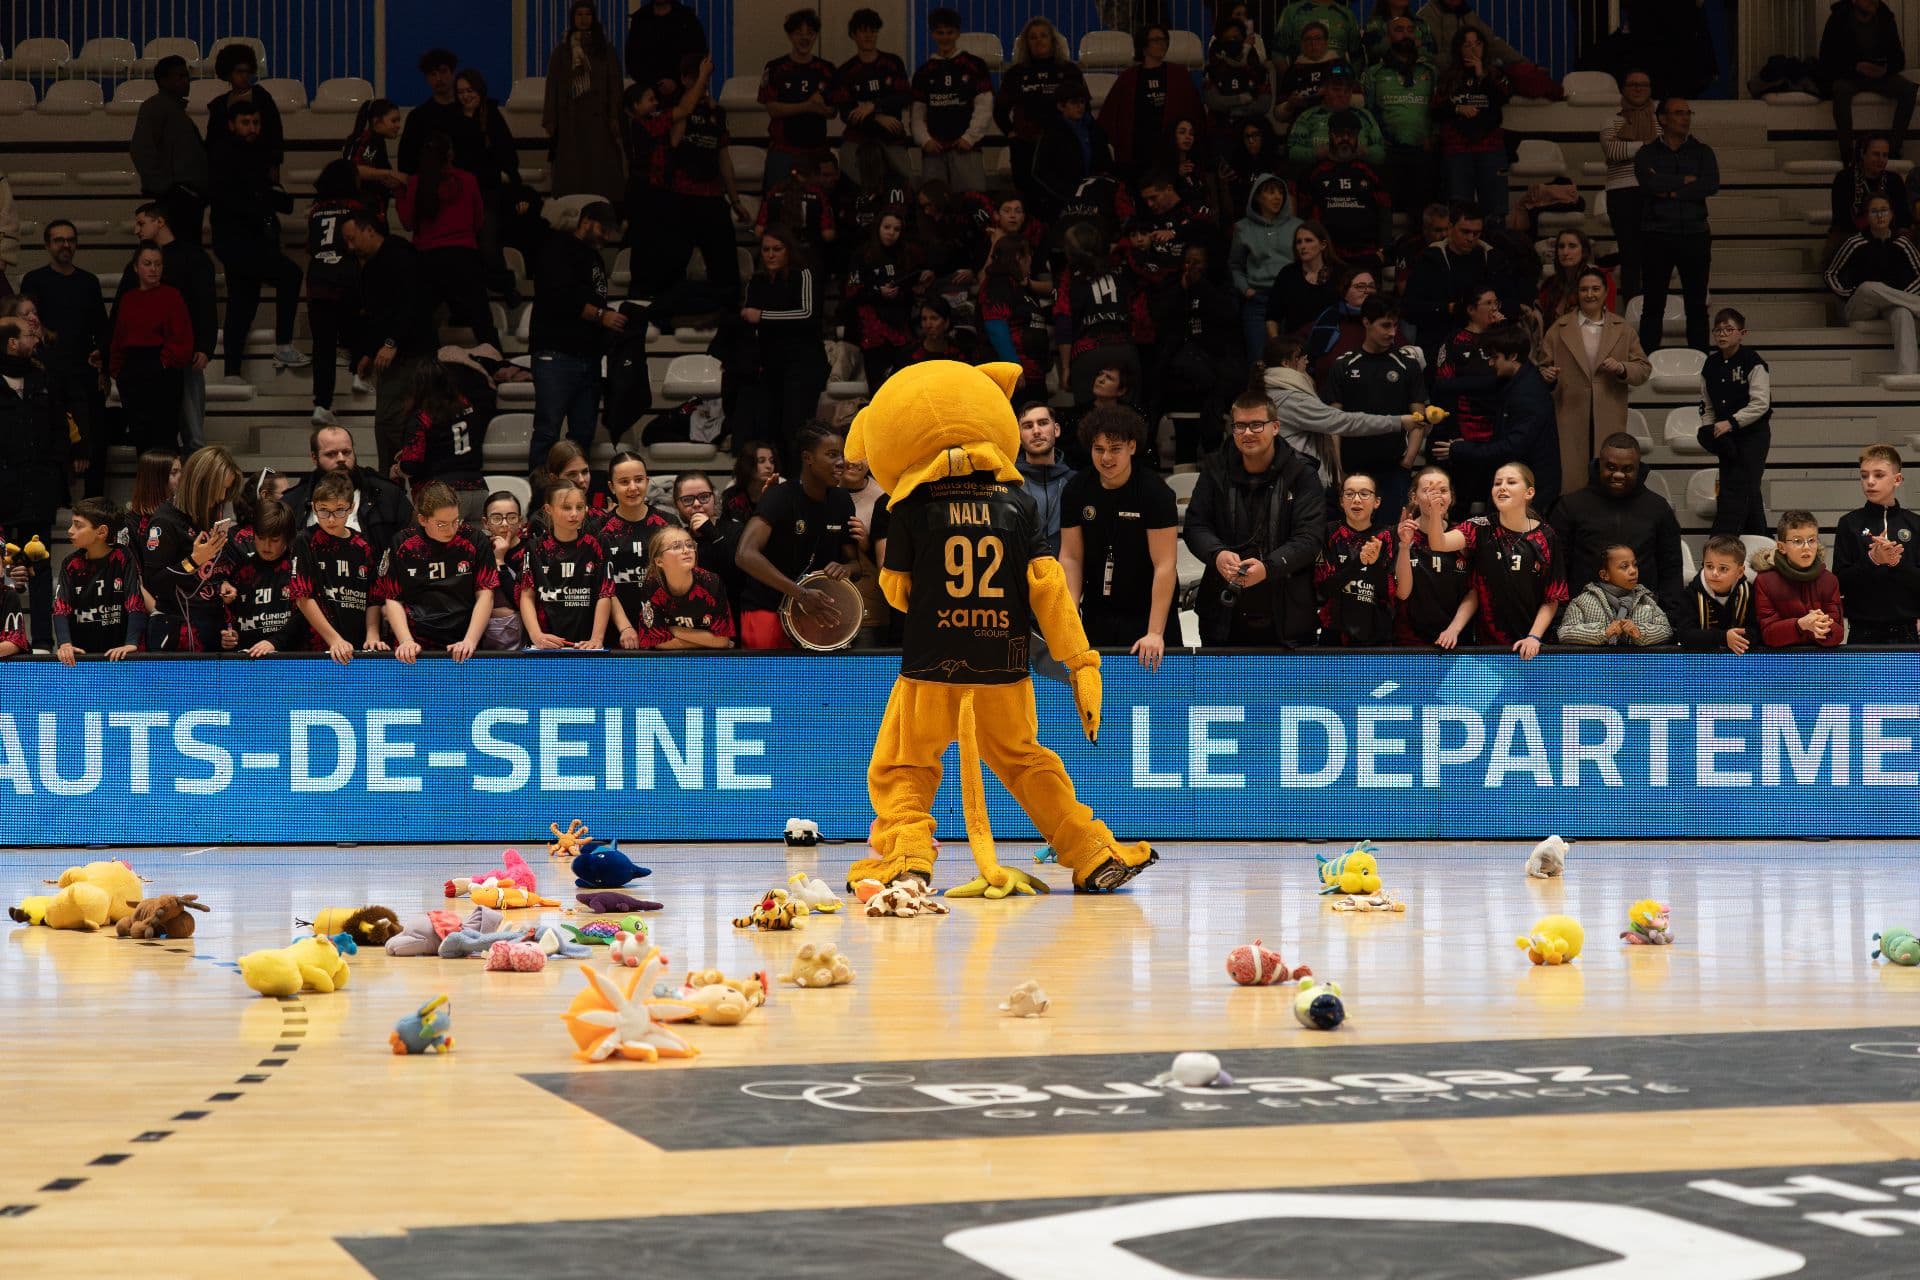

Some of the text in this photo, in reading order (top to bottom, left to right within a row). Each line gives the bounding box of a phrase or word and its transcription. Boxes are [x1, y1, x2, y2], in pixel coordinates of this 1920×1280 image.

[801, 80, 809, 93] 2
[944, 75, 952, 86] 8
[1339, 178, 1352, 190] 15
[320, 216, 337, 246] 3
[1091, 273, 1118, 304] 14
[949, 502, 991, 526] NALA
[428, 562, 446, 579] 21
[944, 535, 1005, 599] 92
[1432, 556, 1442, 573] 4
[1511, 555, 1522, 571] 3
[95, 579, 105, 596] 7
[255, 588, 272, 604] 20
[1132, 680, 1919, 788] LE DÉPARTEME
